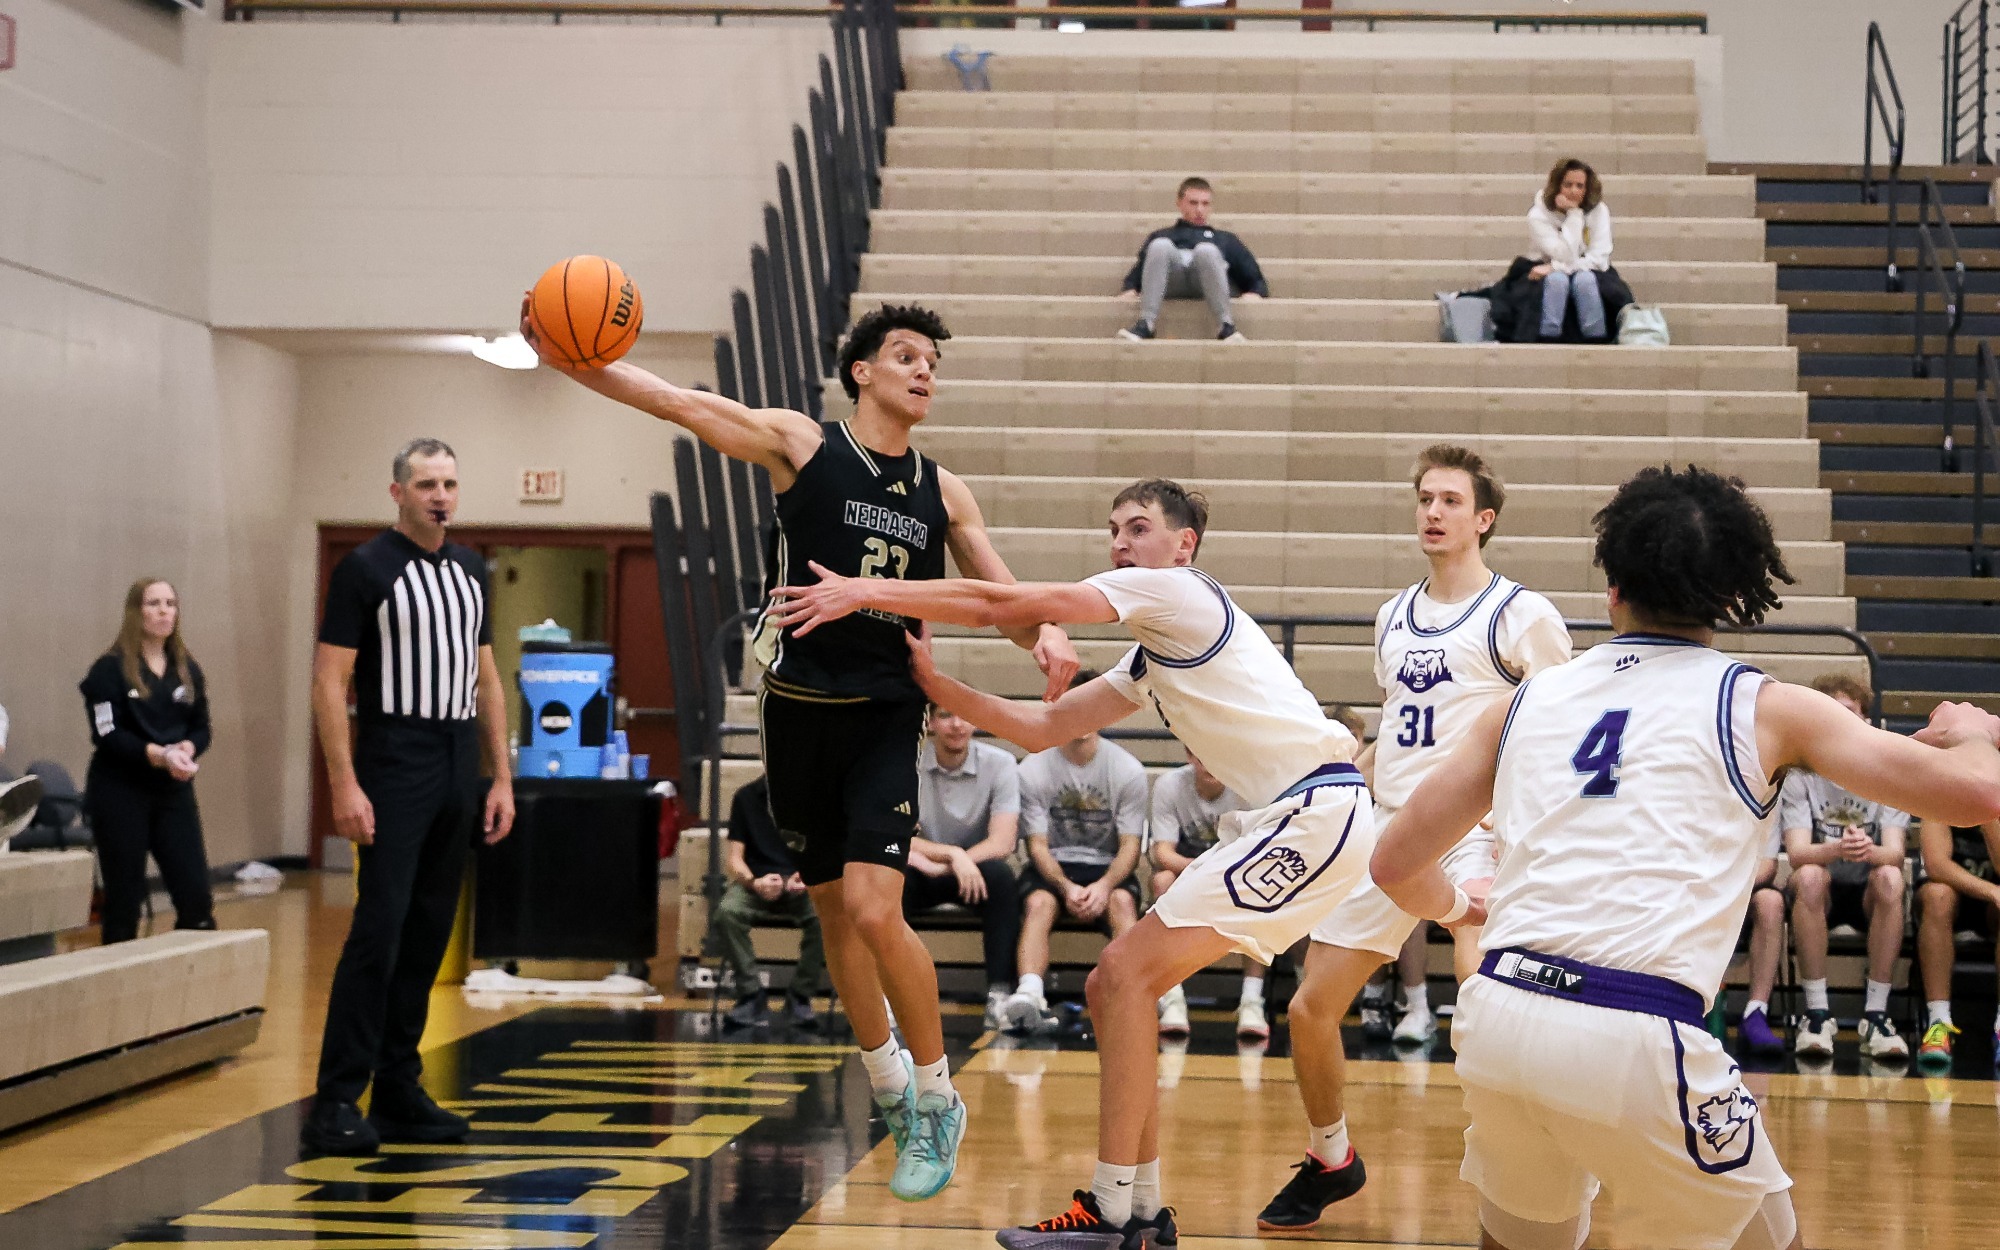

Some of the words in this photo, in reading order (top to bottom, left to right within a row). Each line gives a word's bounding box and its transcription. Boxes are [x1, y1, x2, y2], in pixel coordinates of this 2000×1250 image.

[843, 499, 928, 550] NEBRASKA
[1397, 704, 1436, 748] 31
[1568, 707, 1633, 799] 4
